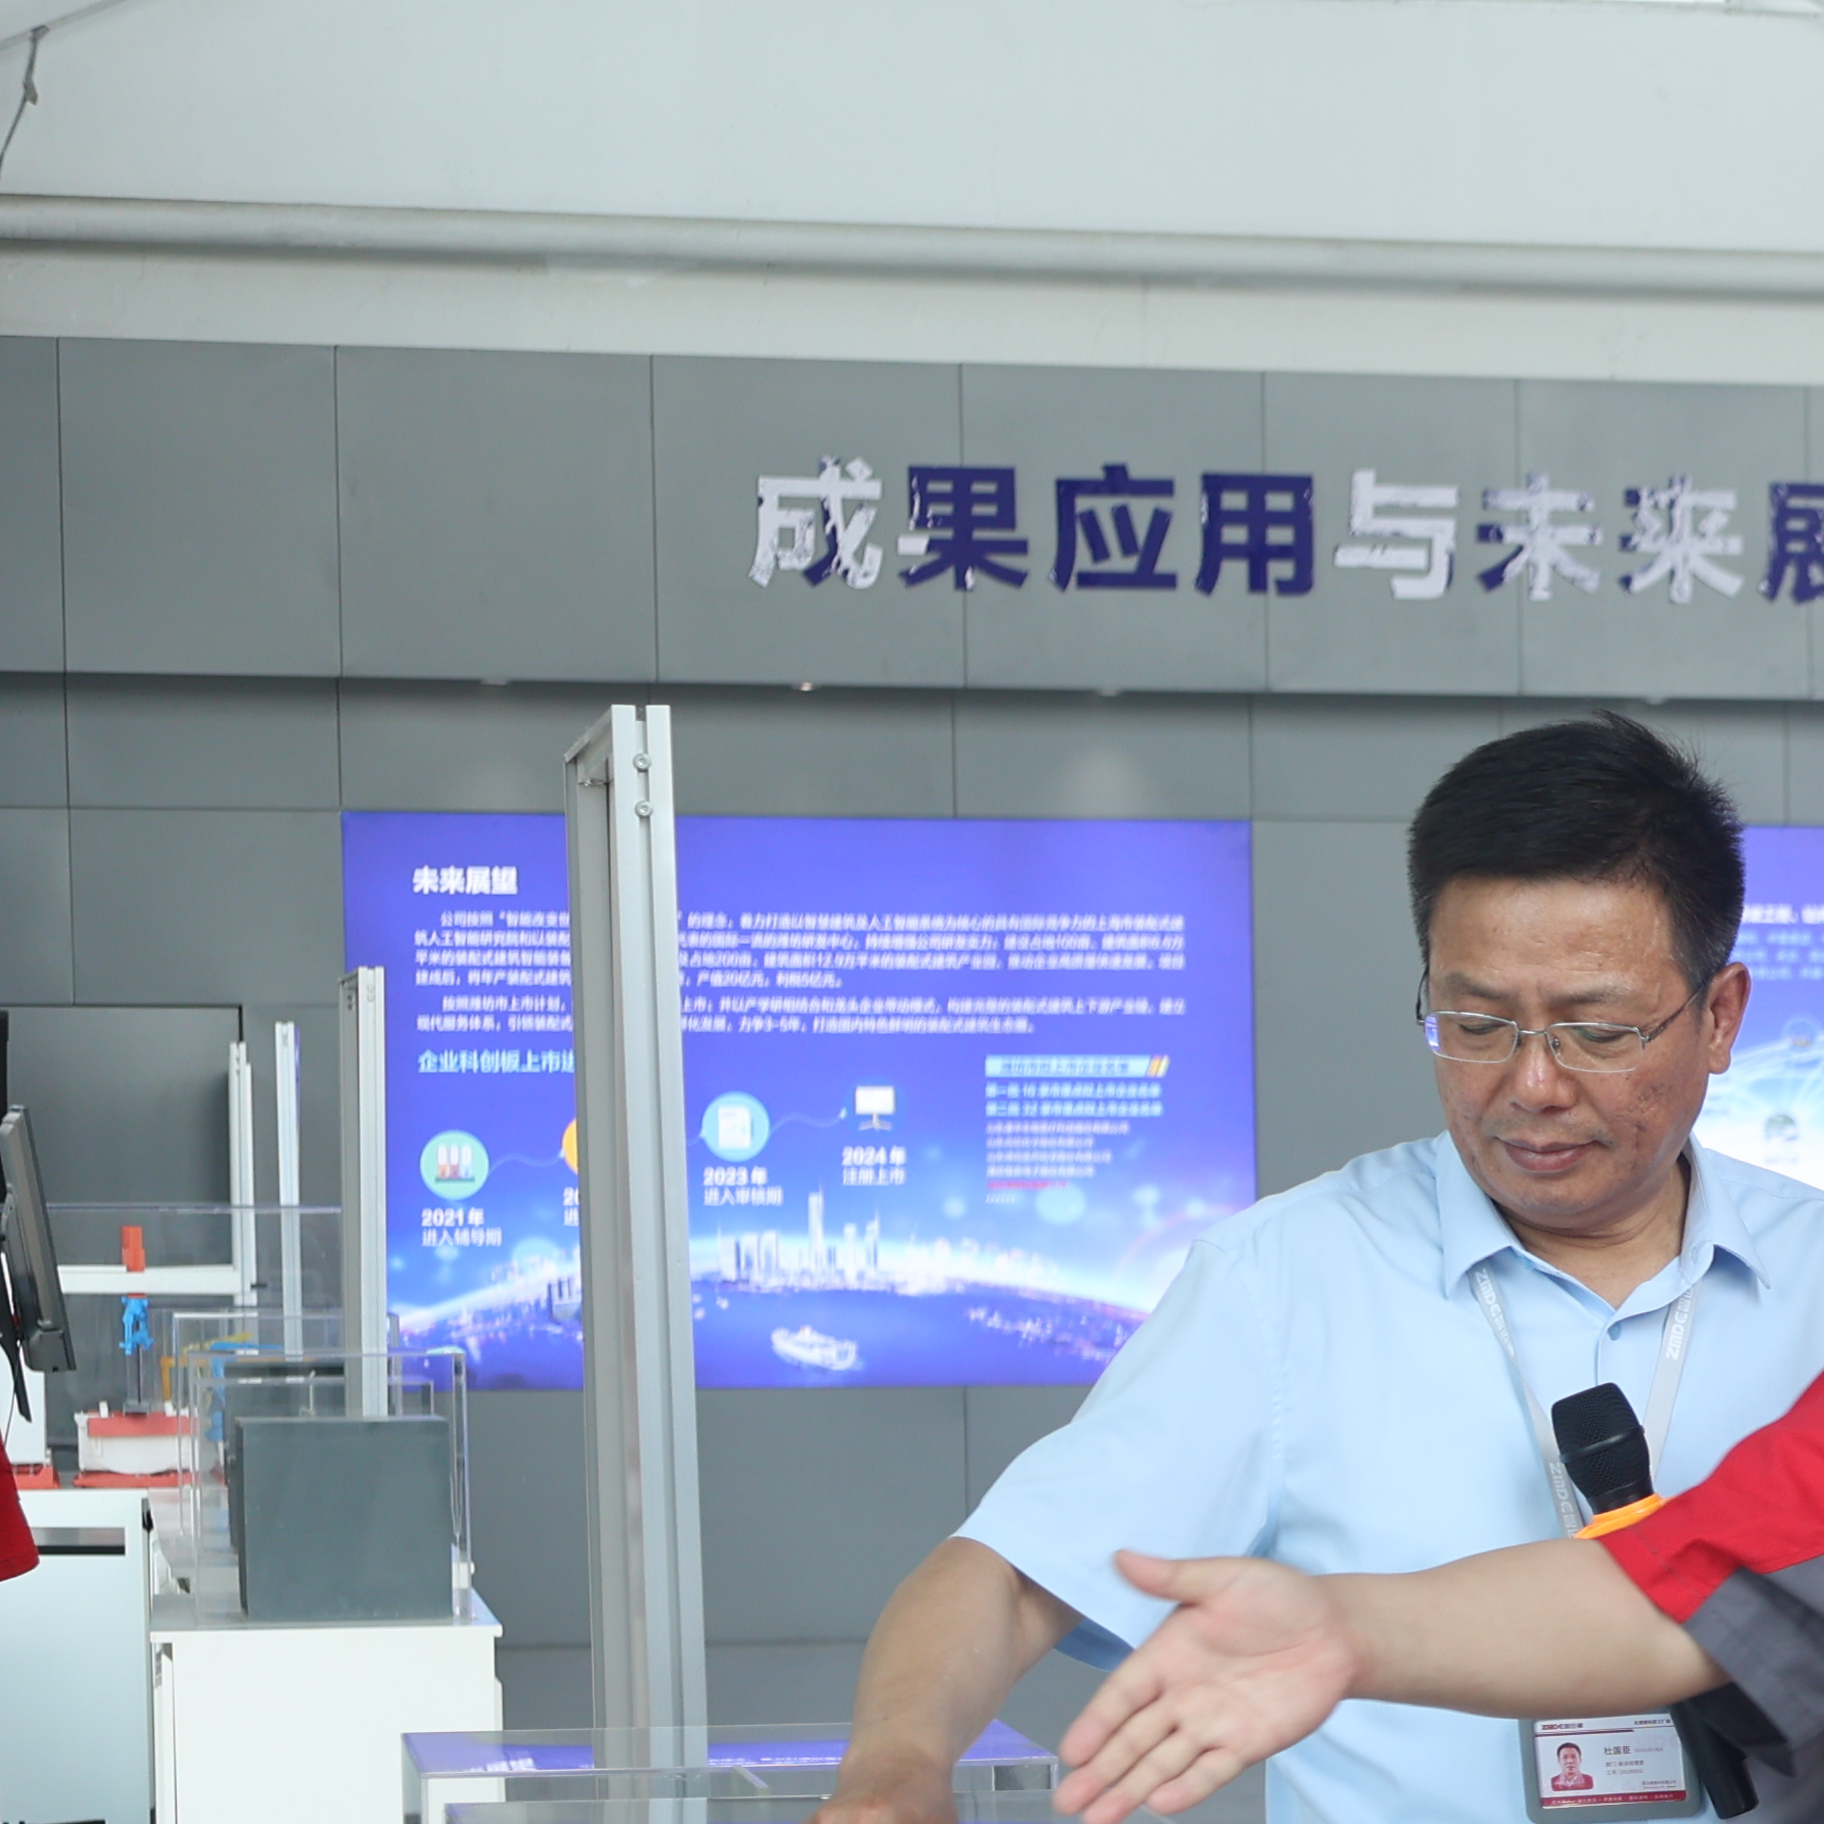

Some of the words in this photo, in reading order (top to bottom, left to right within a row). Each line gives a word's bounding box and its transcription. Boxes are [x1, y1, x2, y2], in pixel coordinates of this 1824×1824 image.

[412, 865, 518, 895] 未来展望
[842, 1167, 906, 1186] 注册上市
[703, 1186, 783, 1206] 进入审核期
[422, 1228, 503, 1247] 进入辅导期
